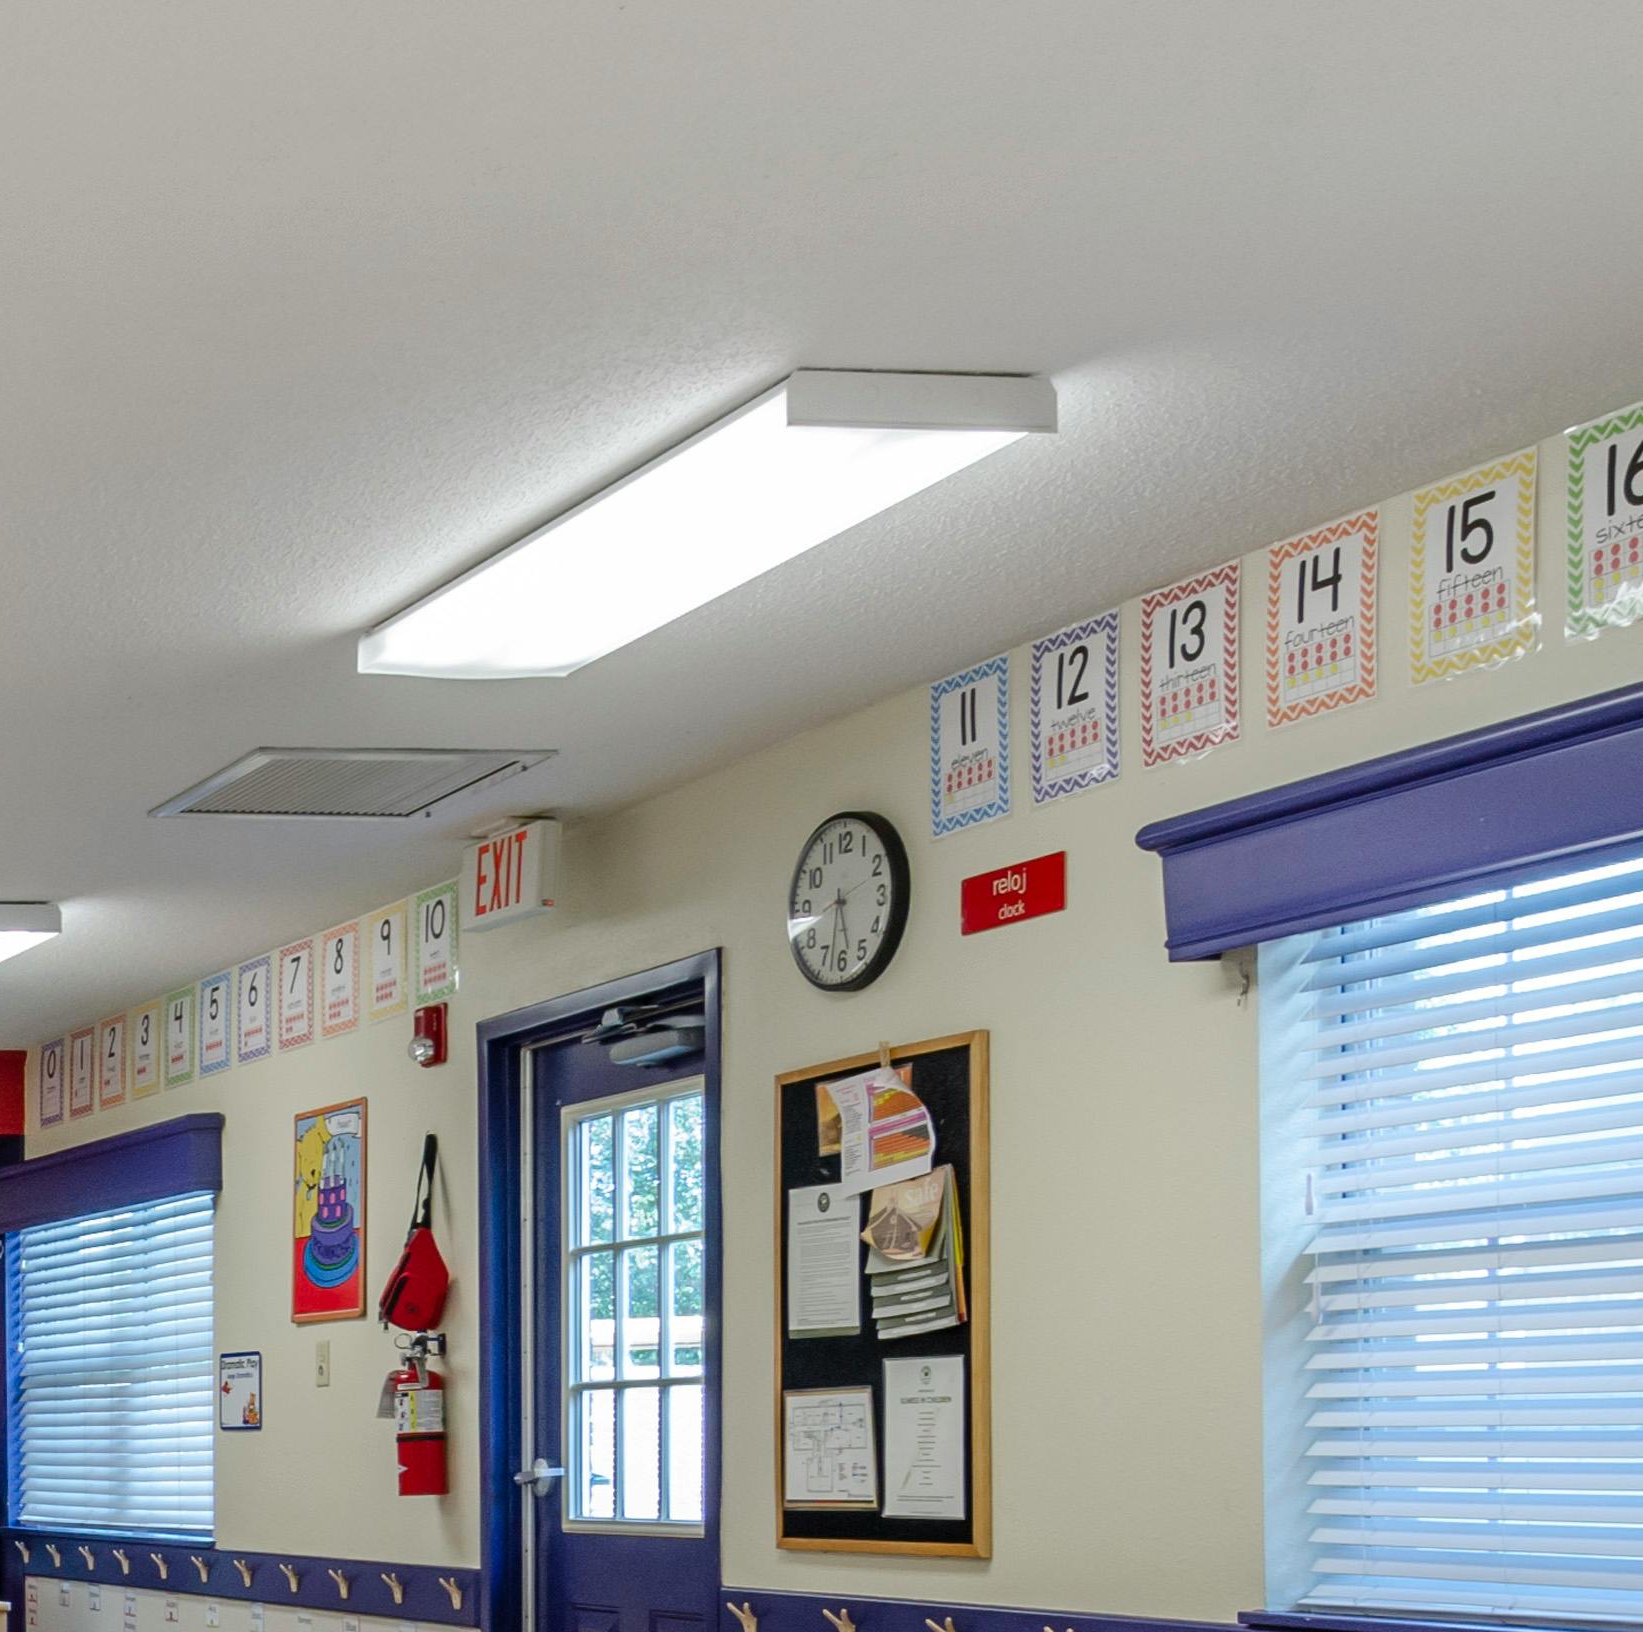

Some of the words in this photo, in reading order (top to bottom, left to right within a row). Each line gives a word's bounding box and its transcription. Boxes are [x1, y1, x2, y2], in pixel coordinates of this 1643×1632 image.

[1446, 490, 1496, 573] 15
[1297, 547, 1342, 624] 14
[1436, 565, 1504, 600] fifteen
[1169, 600, 1207, 669] 13
[1284, 615, 1355, 647] fourteen
[1057, 645, 1089, 709] 12
[1159, 662, 1216, 688] thirteen
[961, 688, 976, 746] 11
[1051, 707, 1097, 730] twelve
[951, 748, 988, 770] eleven
[823, 843, 834, 865] 11
[838, 831, 853, 854] 12
[475, 830, 527, 916] EXIT
[809, 867, 823, 890] 10
[871, 854, 882, 877] 2
[876, 884, 887, 907] 3
[992, 868, 1028, 897] reloj
[423, 899, 445, 943] 10
[871, 915, 880, 934] 4
[997, 899, 1026, 921] clock
[380, 919, 391, 955] 9
[806, 928, 816, 949] 8
[857, 939, 868, 961] 5
[334, 938, 343, 974] 8
[821, 945, 830, 967] 7
[837, 949, 847, 972] 6
[248, 972, 257, 1007] 6
[290, 956, 301, 994] 7
[174, 1001, 183, 1033] 4
[209, 986, 220, 1020] 5
[108, 1026, 116, 1058] 2
[141, 1014, 150, 1045] 3
[47, 1050, 56, 1078] 0
[80, 1040, 84, 1070] 1
